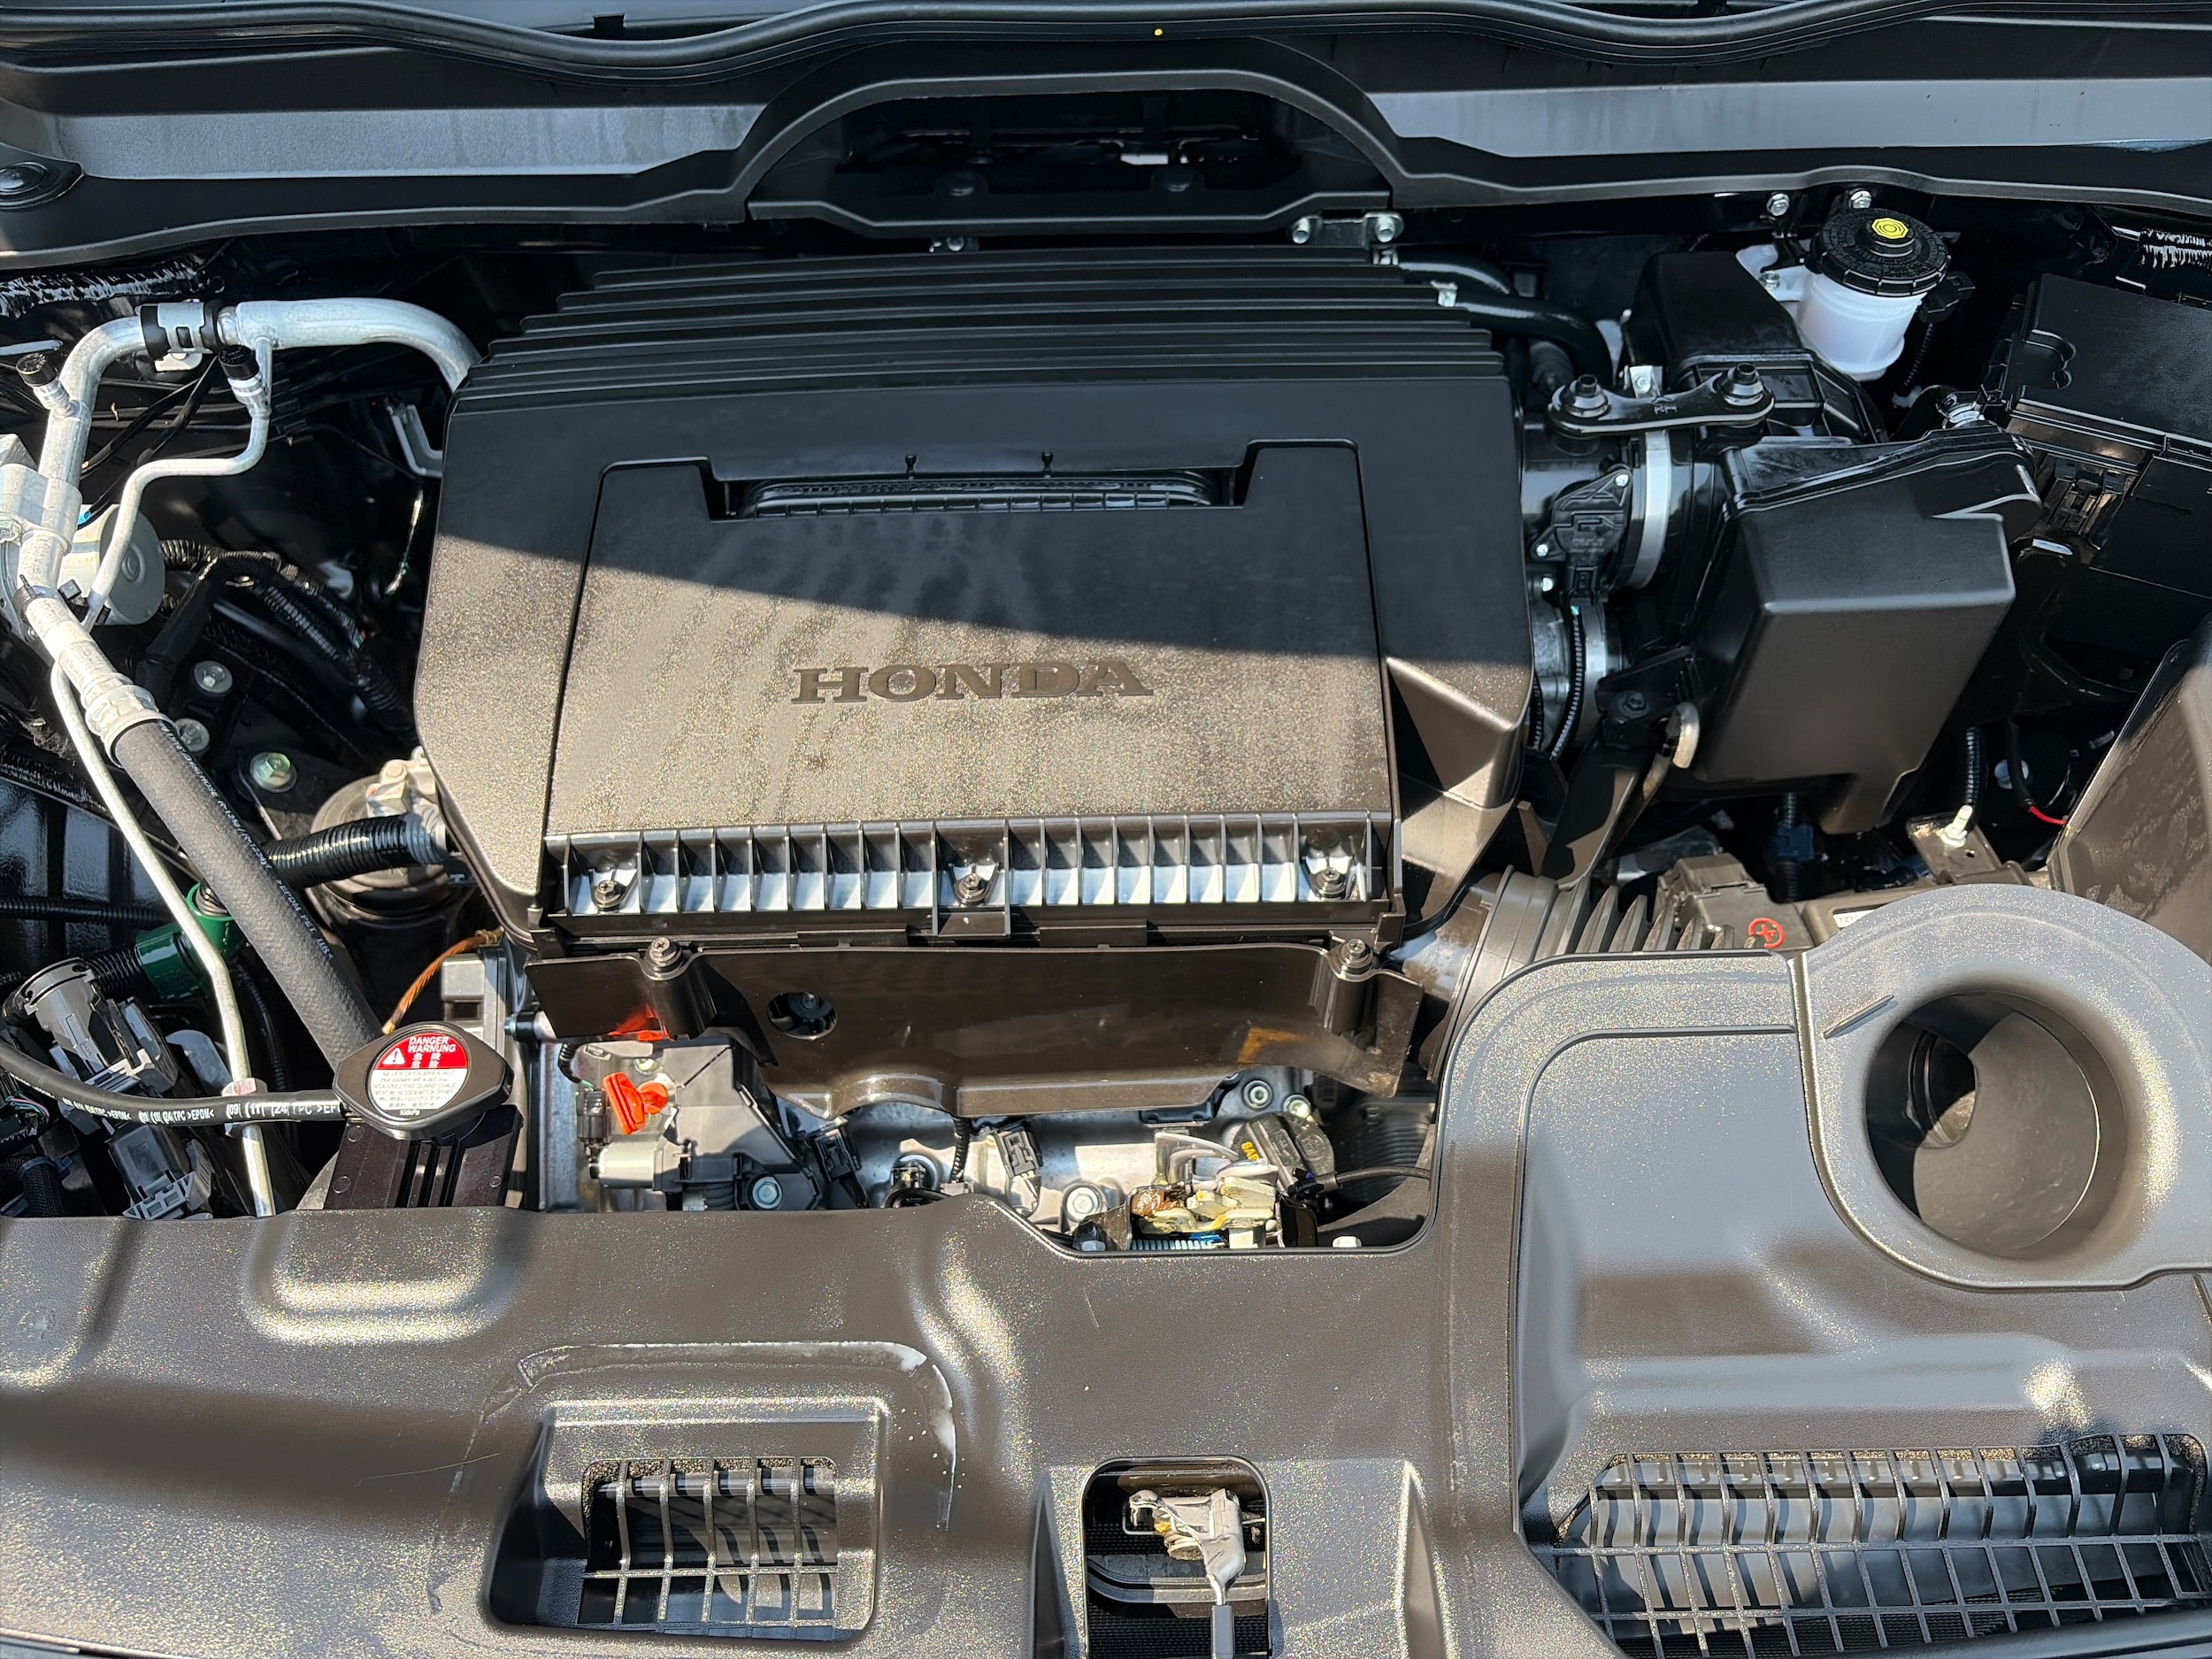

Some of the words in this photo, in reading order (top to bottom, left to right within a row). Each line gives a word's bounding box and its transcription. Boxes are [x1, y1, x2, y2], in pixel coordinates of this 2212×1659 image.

[791, 659, 1154, 703] HONDA
[199, 775, 219, 797] HOSE
[301, 914, 317, 933] PET
[408, 1044, 457, 1053] WARNUNG
[173, 1110, 186, 1122] TPC
